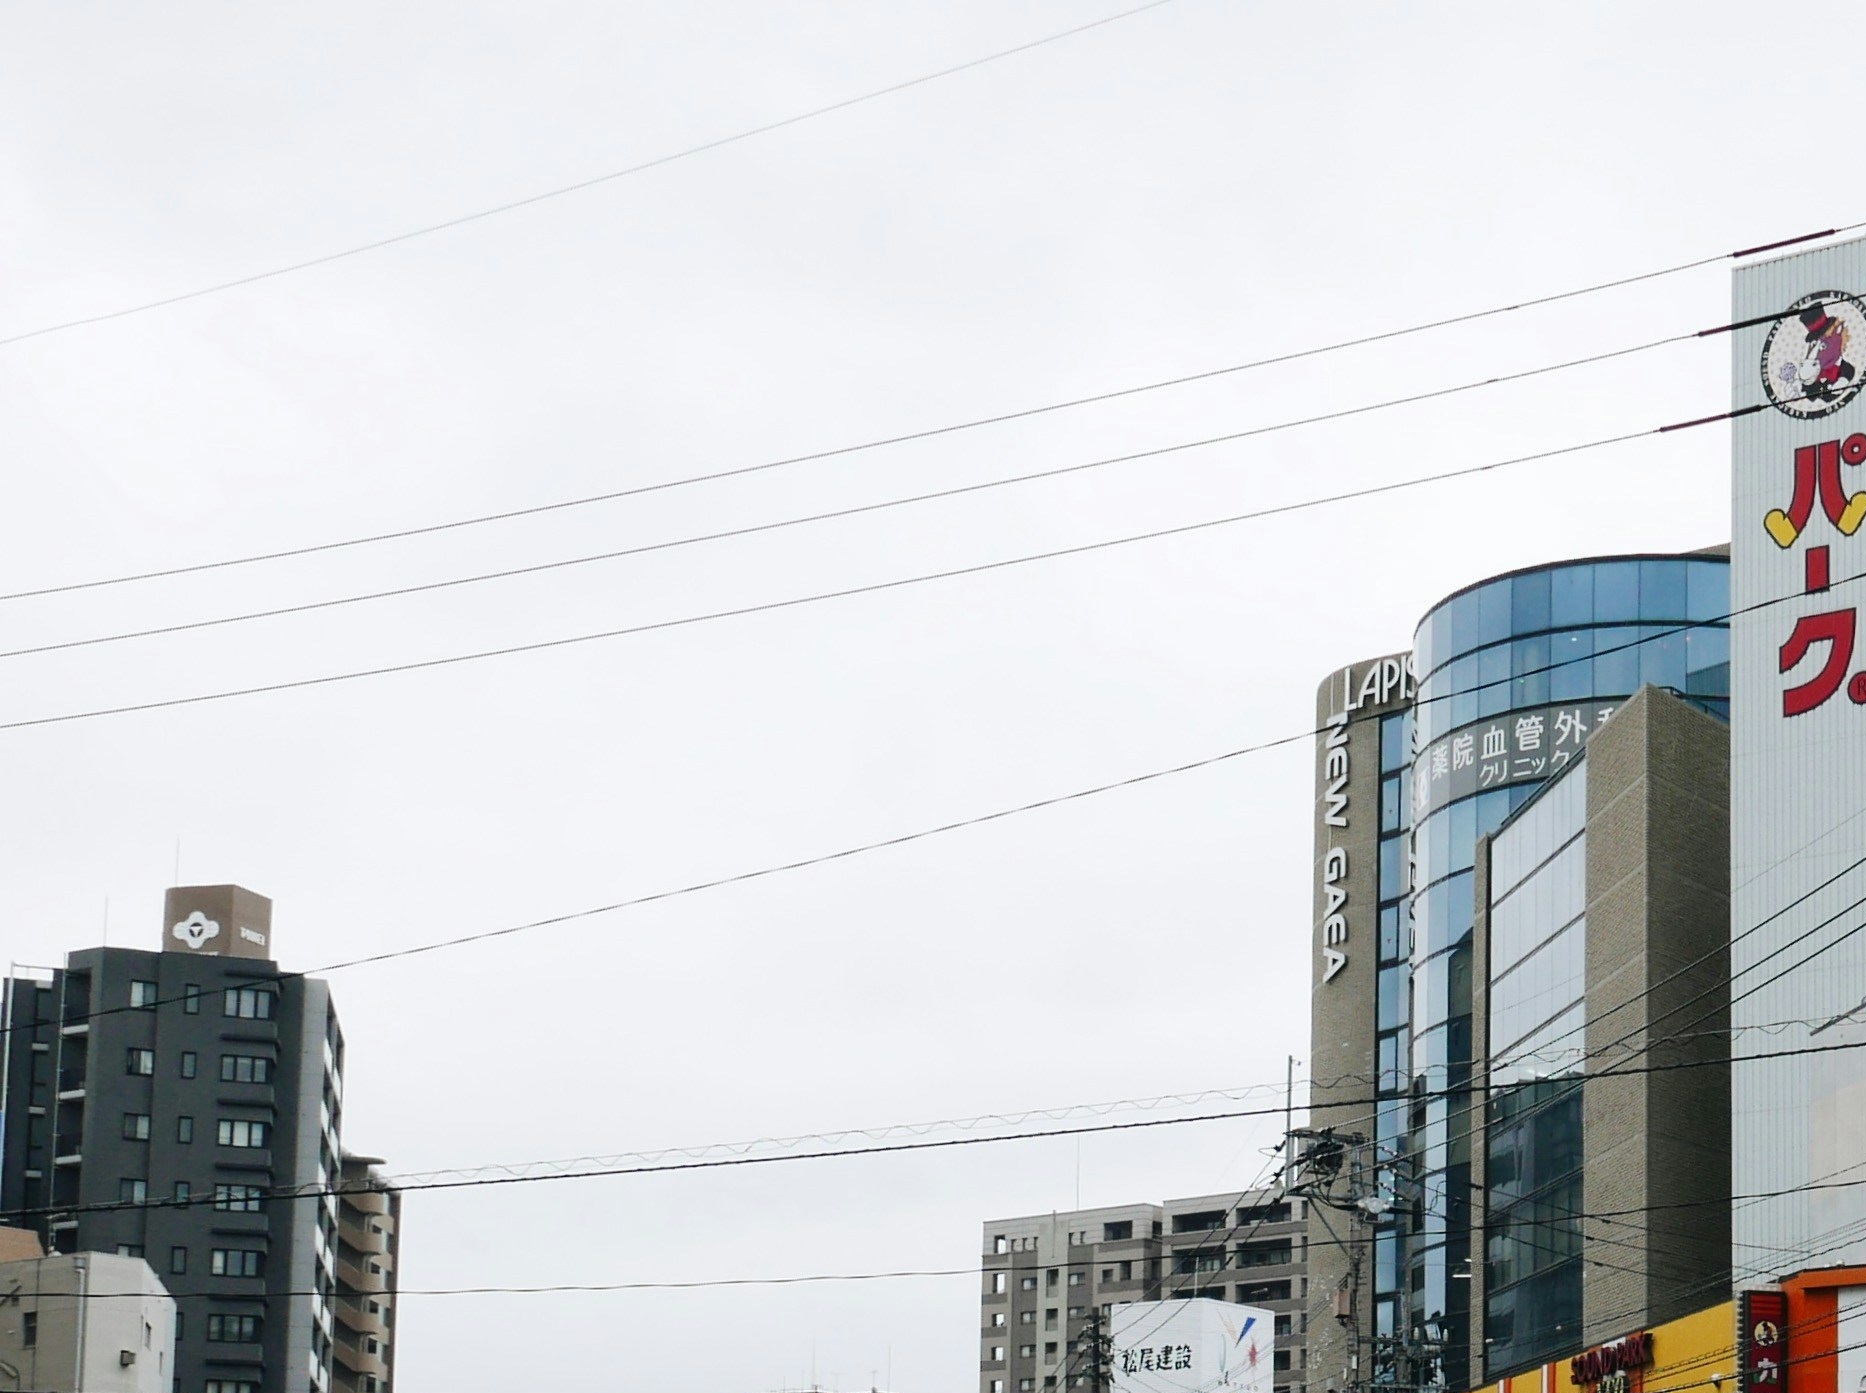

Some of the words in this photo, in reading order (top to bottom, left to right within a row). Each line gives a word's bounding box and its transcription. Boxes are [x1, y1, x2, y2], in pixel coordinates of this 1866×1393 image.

[1325, 711, 1351, 827] NEW
[1480, 750, 1569, 787] クリニック
[1322, 846, 1347, 983] GAEA
[1123, 1345, 1191, 1373] 松尾建設
